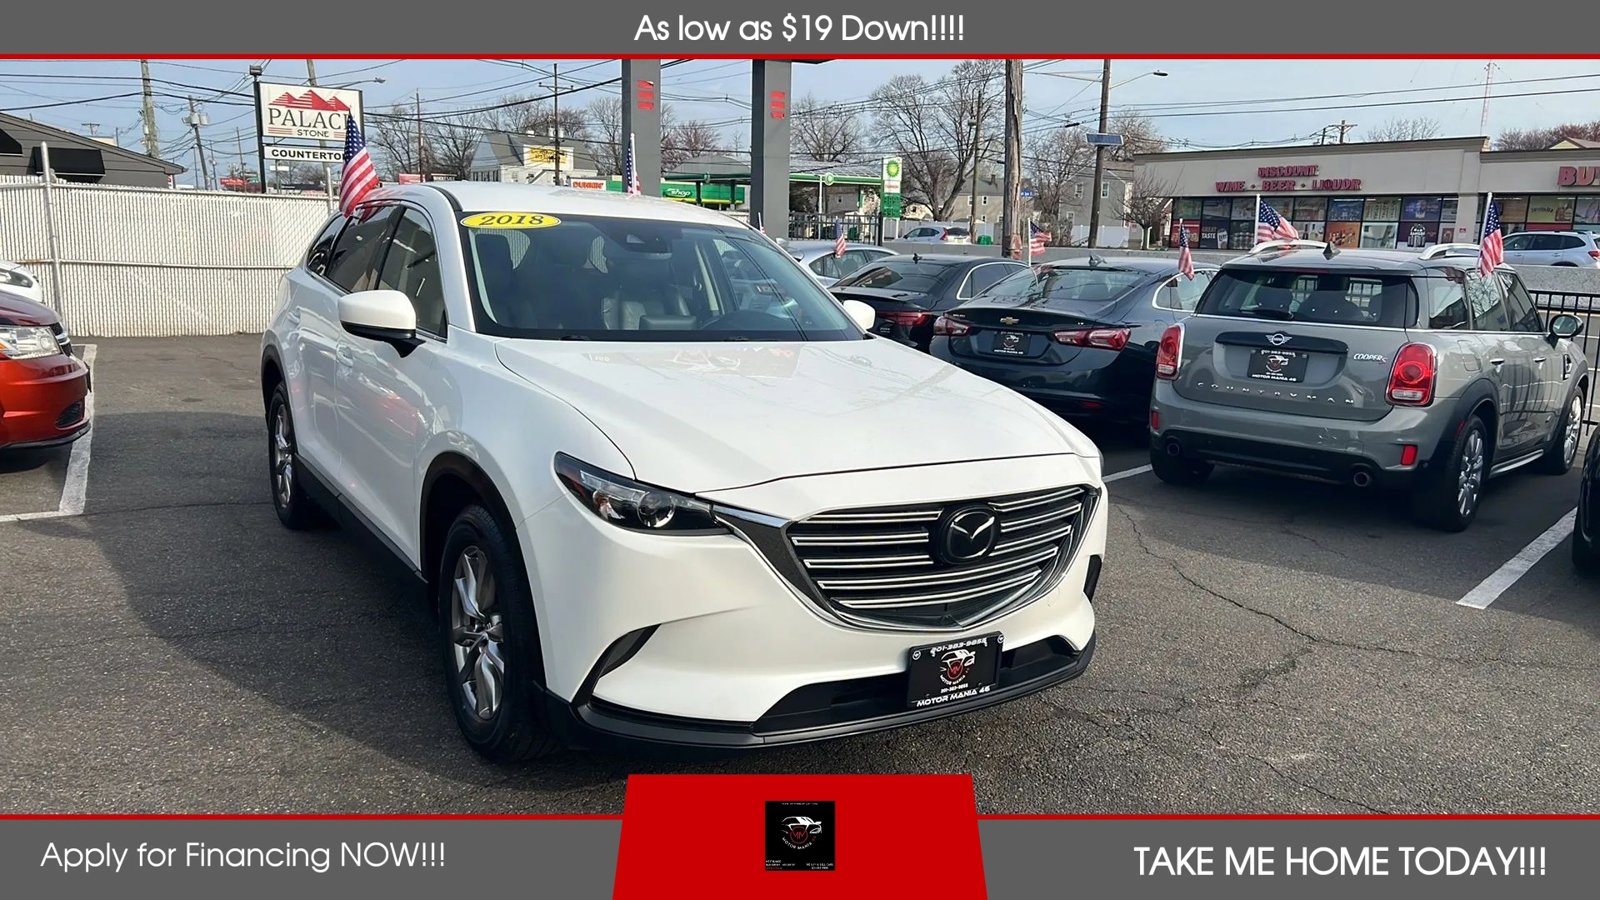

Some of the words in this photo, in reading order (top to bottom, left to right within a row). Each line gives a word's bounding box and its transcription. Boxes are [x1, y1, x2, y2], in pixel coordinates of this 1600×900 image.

[297, 129, 330, 138] STONE
[1258, 164, 1319, 178] DISCOUNT
[1215, 181, 1246, 193] WINE
[1261, 179, 1296, 192] BEER
[1311, 178, 1362, 191] LIQUOR
[479, 213, 545, 227] 2018
[916, 695, 949, 707] MOTOR
[949, 688, 978, 701] MANIA
